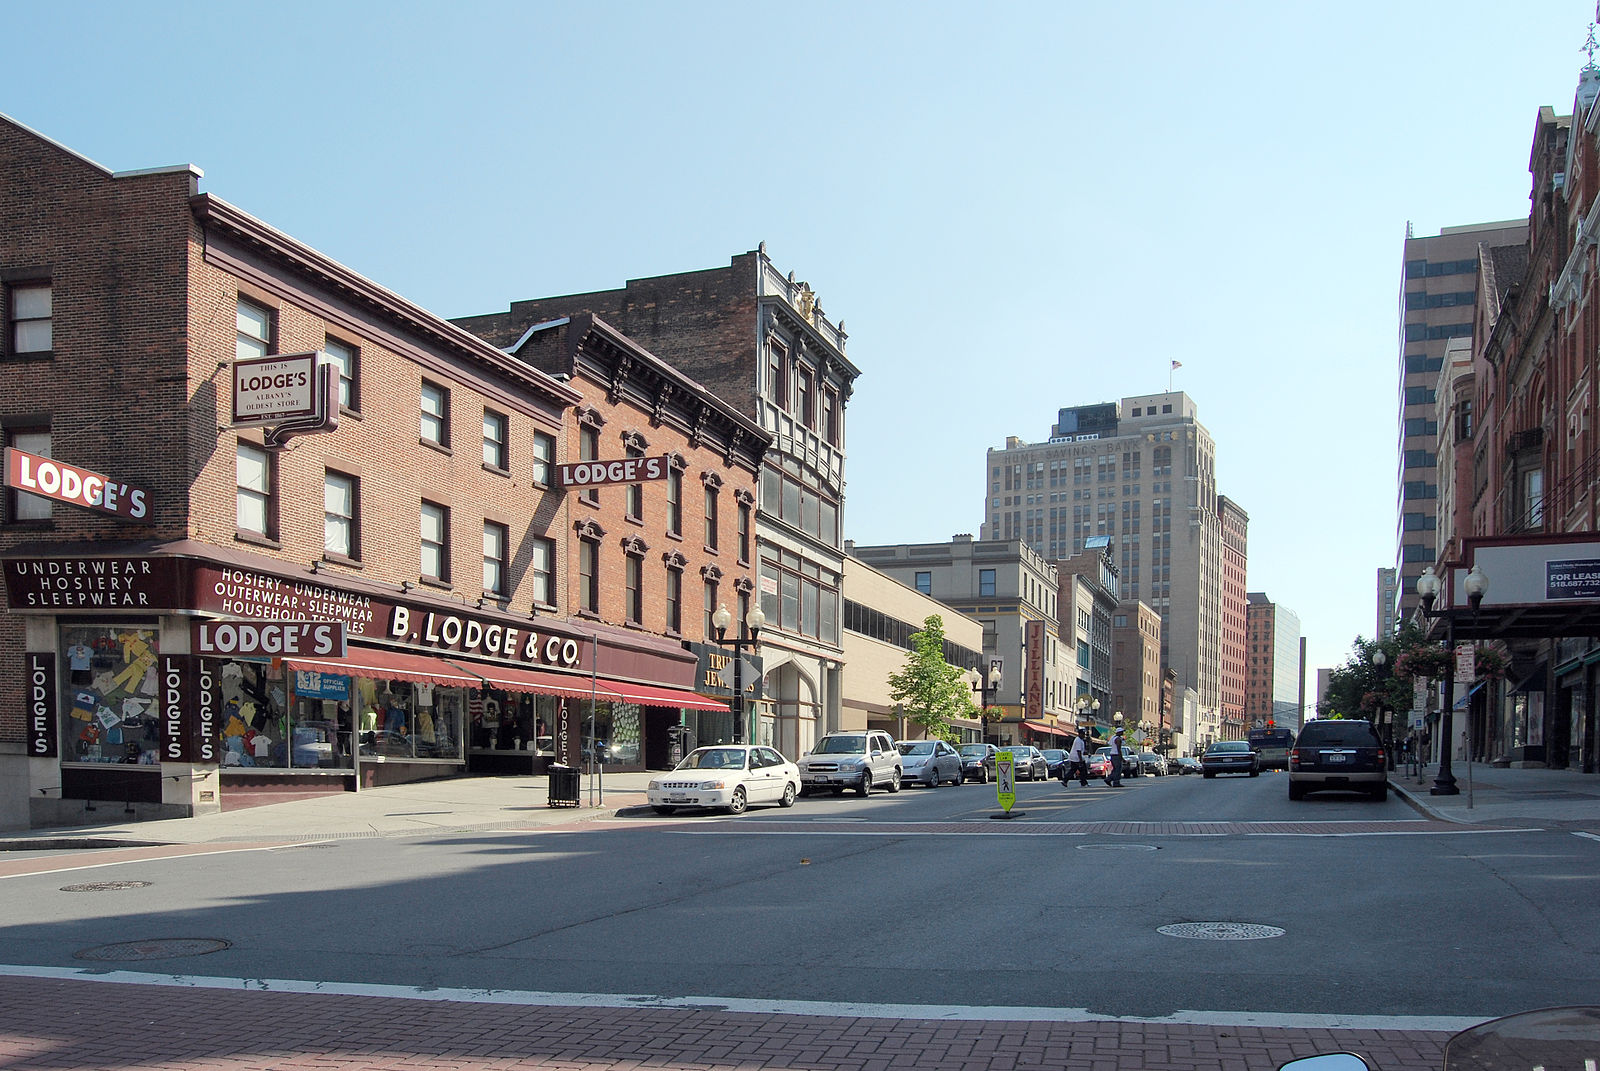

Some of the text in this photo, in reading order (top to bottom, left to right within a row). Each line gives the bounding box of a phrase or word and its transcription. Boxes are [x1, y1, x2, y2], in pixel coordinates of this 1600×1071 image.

[260, 364, 277, 372] THIS
[240, 371, 307, 392] LODGE'S
[256, 392, 292, 401] ALBANY'S
[277, 400, 301, 408] STORE
[1046, 445, 1097, 459] SAVINGS
[1106, 439, 1141, 453] BANK
[562, 460, 661, 485] LODGE'S
[20, 455, 146, 519] LODGE'S
[17, 561, 151, 575] UNDERWEAR
[1550, 573, 1571, 581] FOR
[40, 576, 134, 590] HOSIERY
[222, 568, 371, 609] HOSIERY UNDERWEAR
[1550, 580, 1600, 588] 518.687.732
[28, 592, 149, 606] SLEEPWEAR
[214, 582, 373, 623] OUTERWEAR SLEEPWEAR
[222, 598, 306, 621] HOUSEHOLD
[200, 624, 334, 655] LODGE'S
[392, 605, 581, 665] B. LODGE & CO.
[1029, 625, 1041, 714] JILLIAN'S
